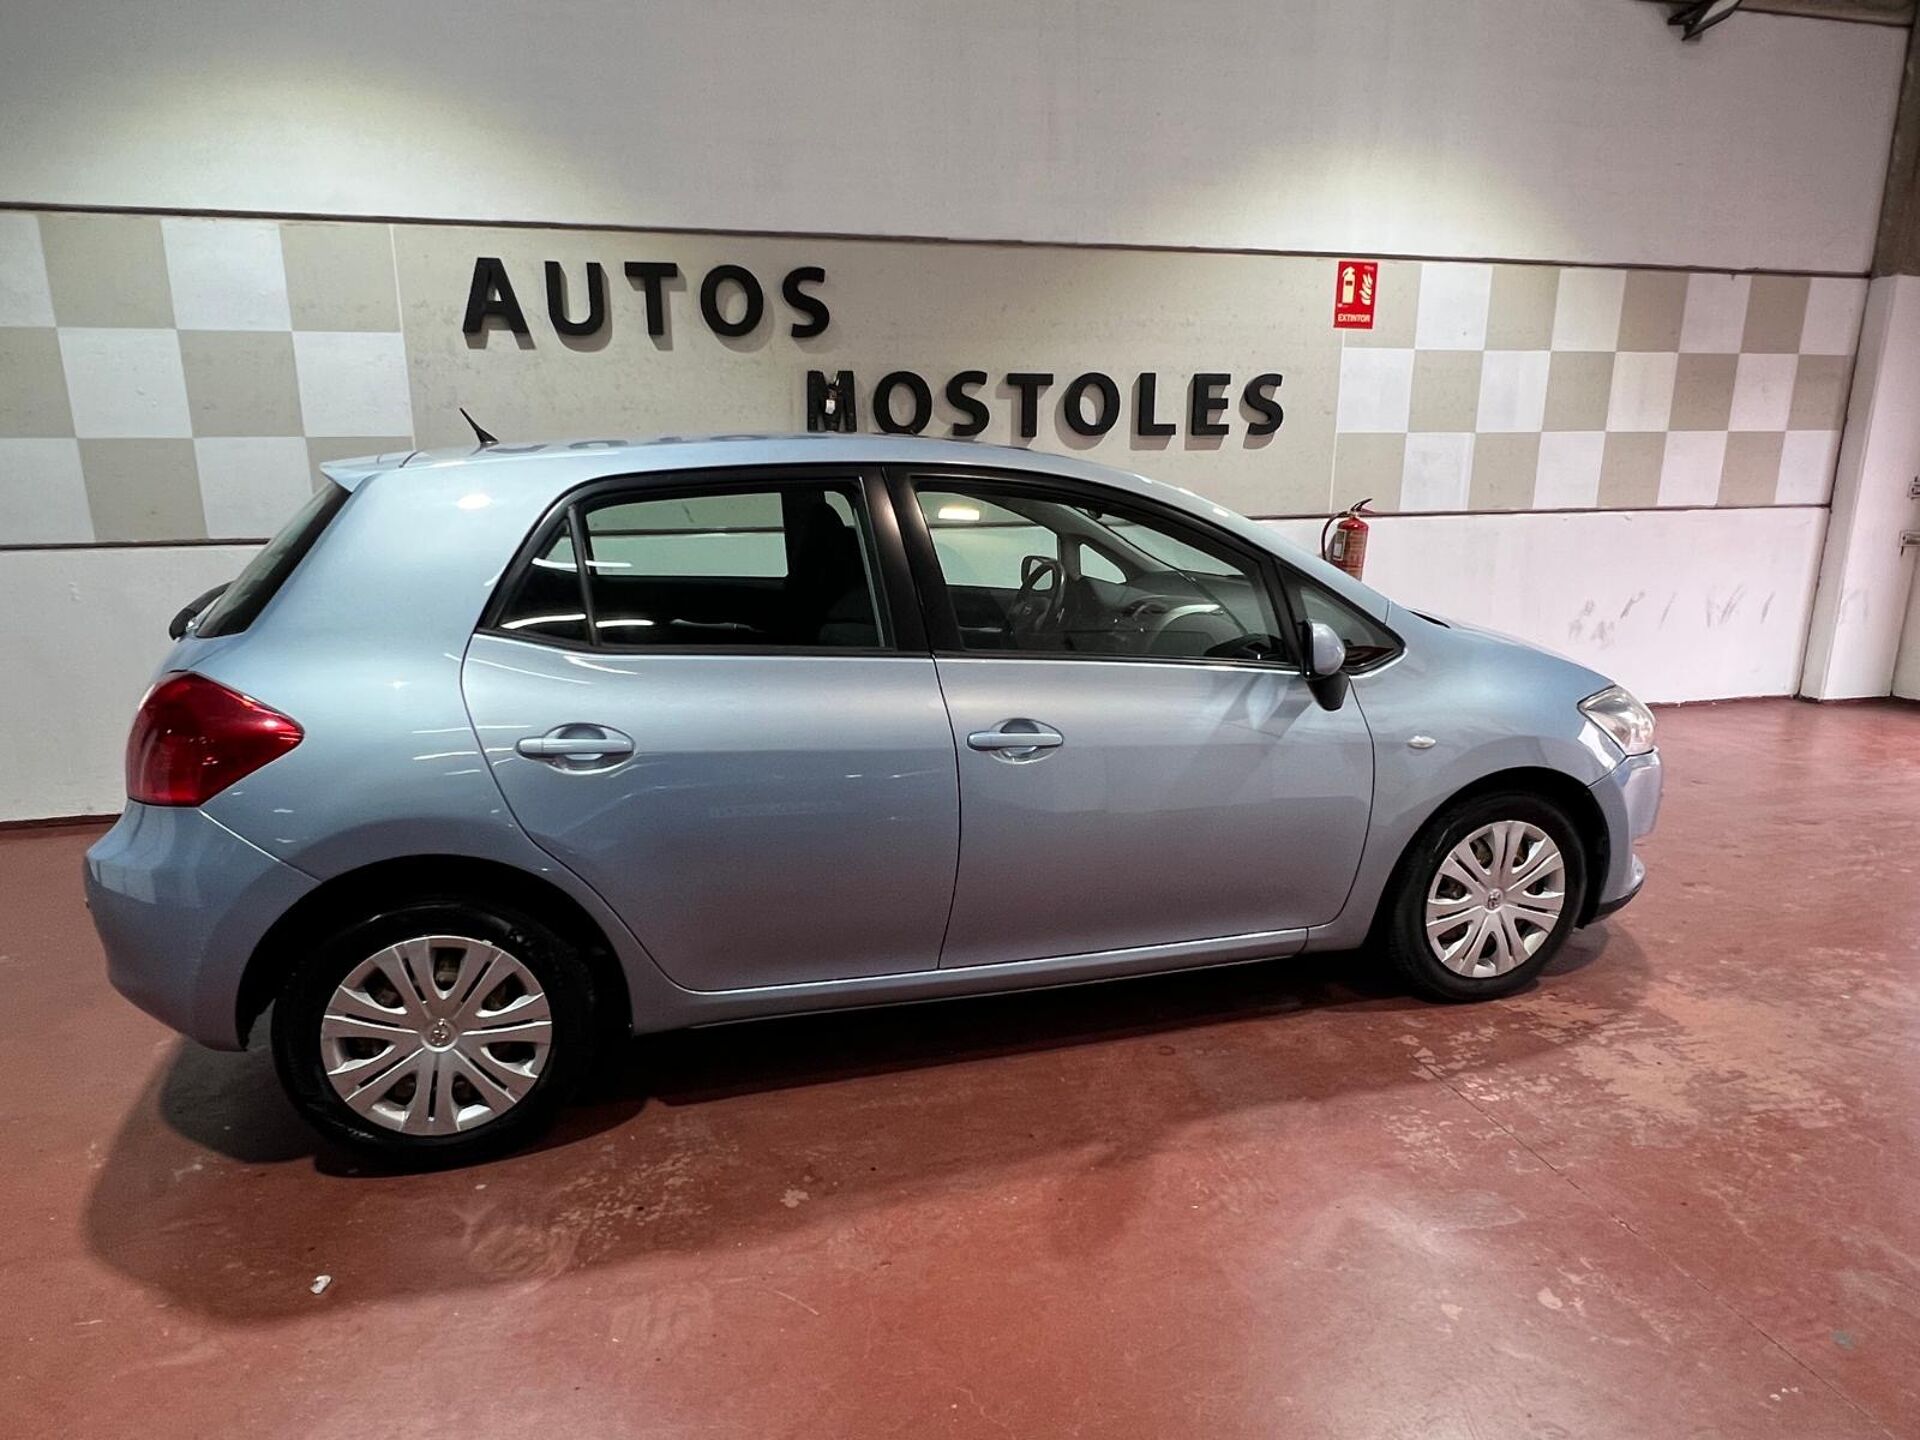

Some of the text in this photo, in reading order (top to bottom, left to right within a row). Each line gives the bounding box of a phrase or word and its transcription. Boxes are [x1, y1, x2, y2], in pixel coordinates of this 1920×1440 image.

[463, 257, 831, 339] AUTOS
[1337, 313, 1371, 323] EXTINTOR
[807, 370, 1285, 437] MOSTOLES
